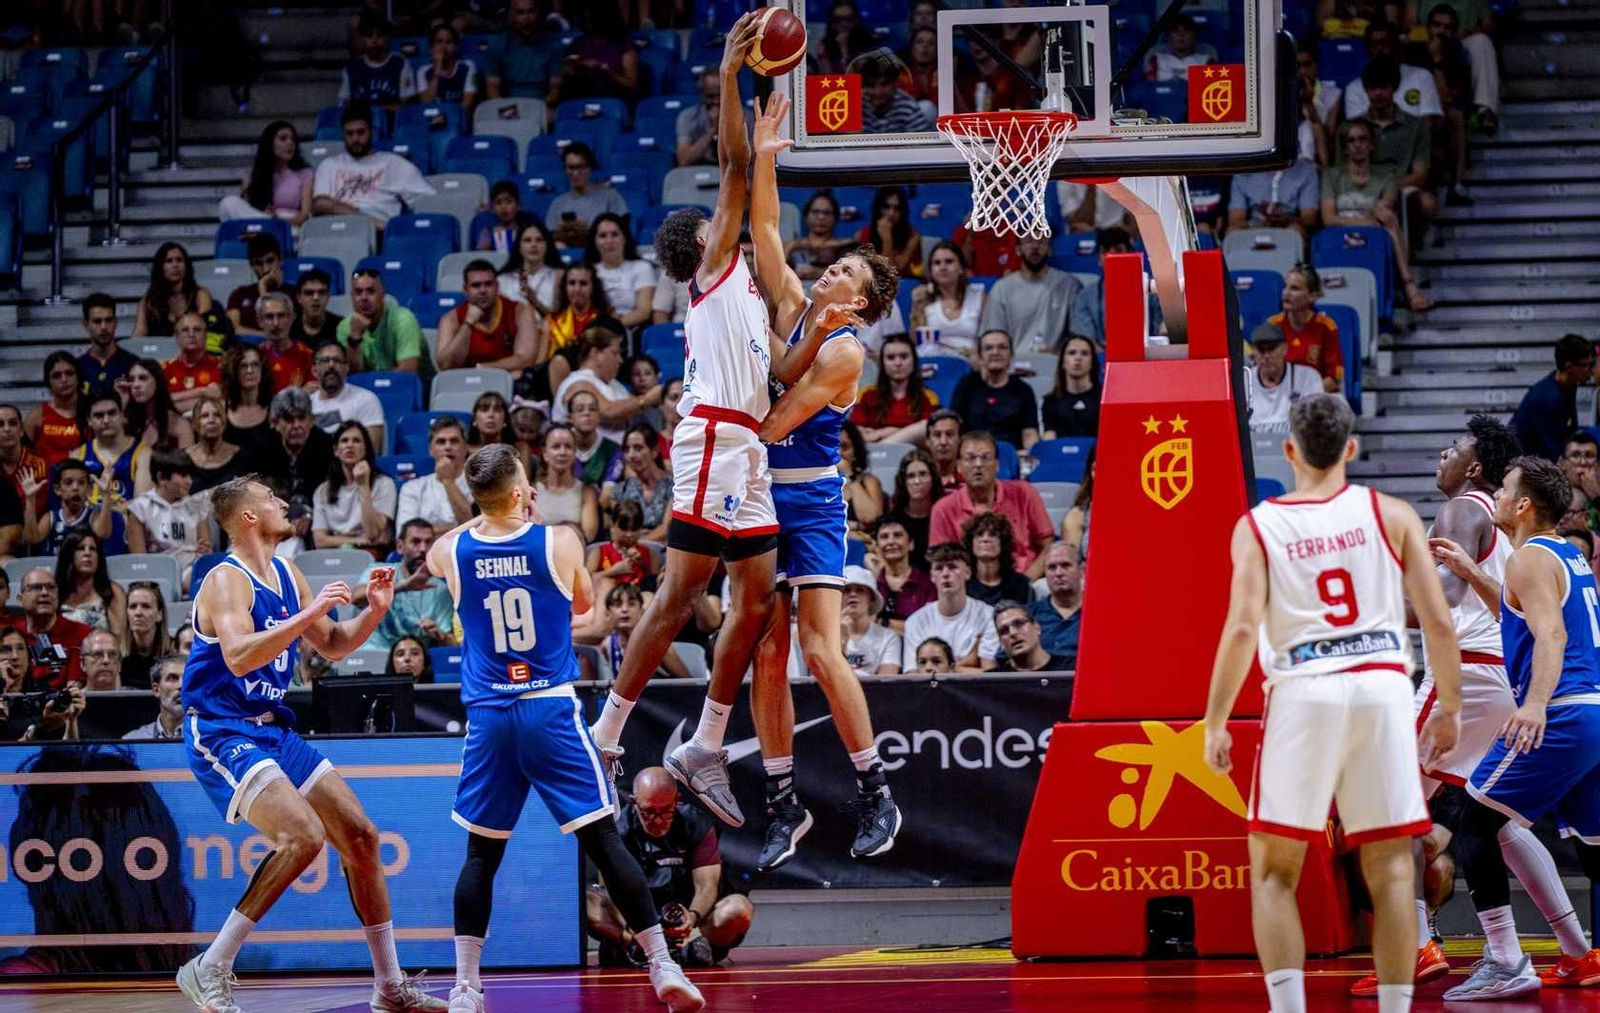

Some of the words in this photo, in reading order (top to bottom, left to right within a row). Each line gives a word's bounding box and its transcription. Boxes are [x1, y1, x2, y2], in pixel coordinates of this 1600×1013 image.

[1171, 442, 1188, 450] FEB
[1286, 528, 1366, 562] FERRANDO
[475, 555, 531, 579] SEHNAL
[1316, 567, 1359, 627] 9
[483, 587, 536, 653] 19
[491, 682, 531, 690] SKUPINA
[0, 837, 104, 883] co
[123, 836, 169, 881] o
[186, 831, 410, 893] nego
